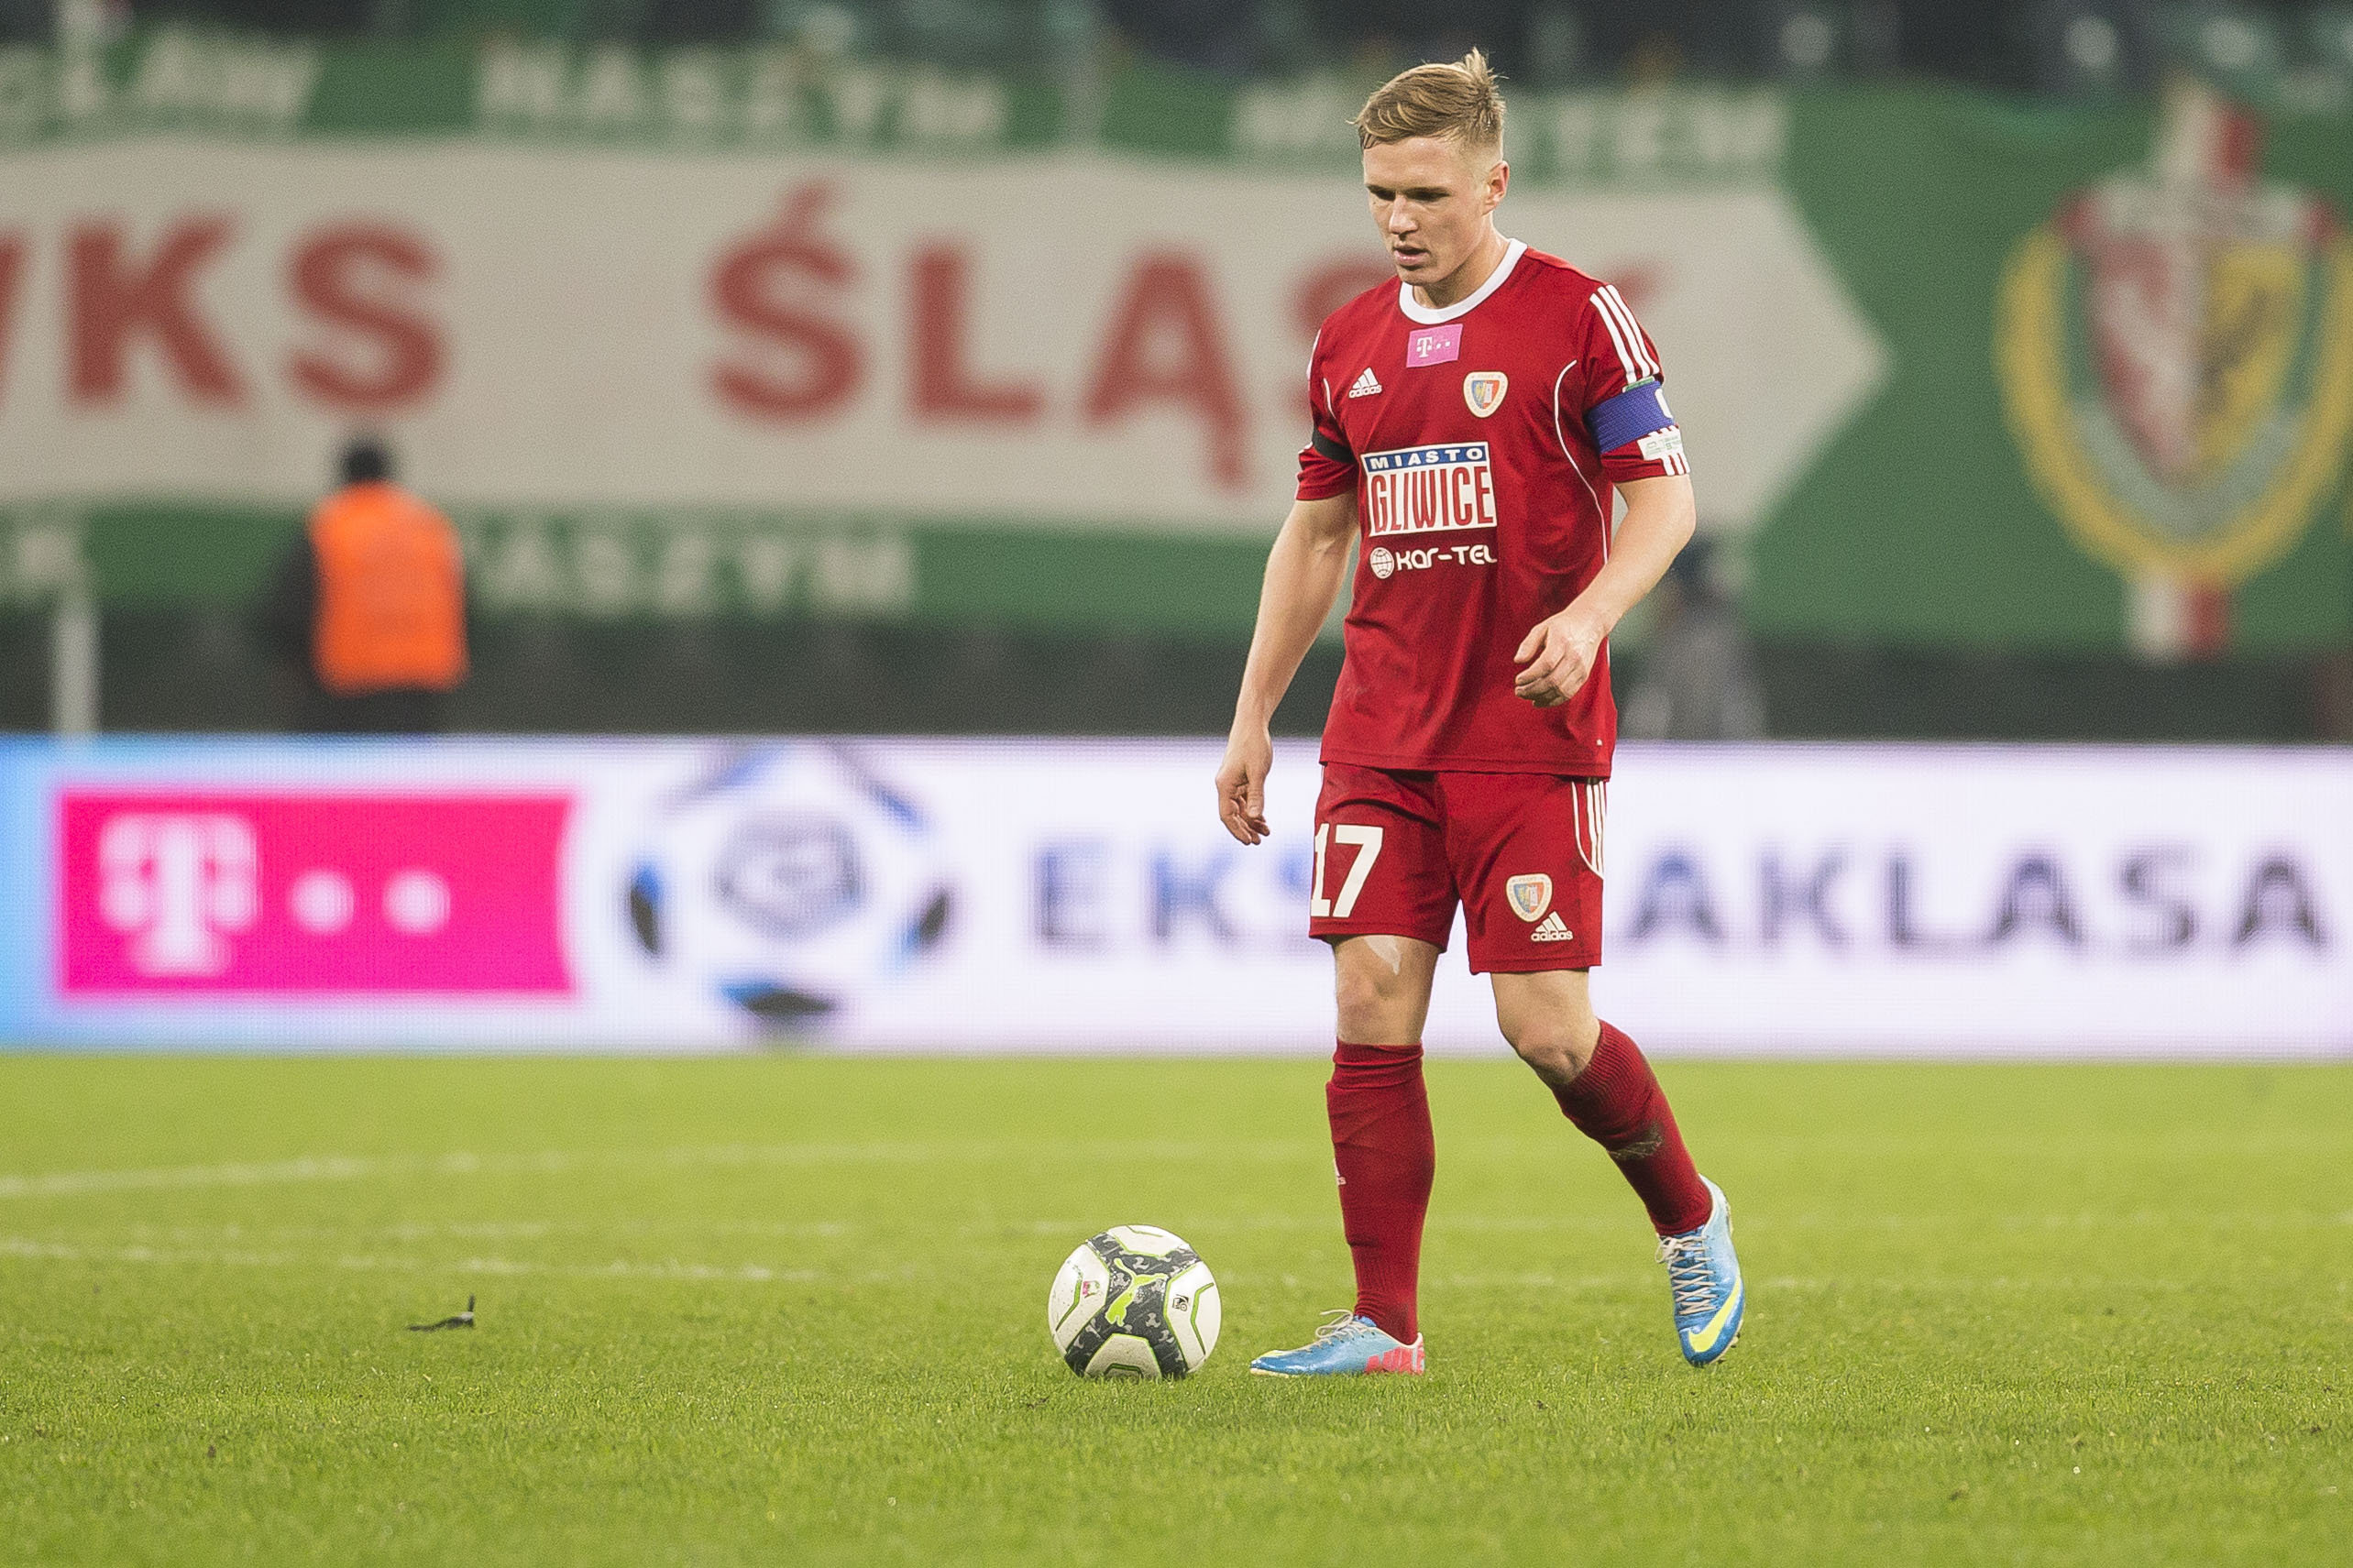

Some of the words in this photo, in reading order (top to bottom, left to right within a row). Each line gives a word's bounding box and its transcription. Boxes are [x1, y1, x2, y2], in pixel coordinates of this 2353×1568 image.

[0, 209, 451, 418] KS
[1349, 385, 1382, 399] adidas
[1370, 447, 1483, 470] MIASTO
[1371, 466, 1494, 533] GLIWICE
[463, 530, 918, 616] ASZYM
[1310, 822, 1384, 918] 17
[1531, 929, 1574, 942] adidas
